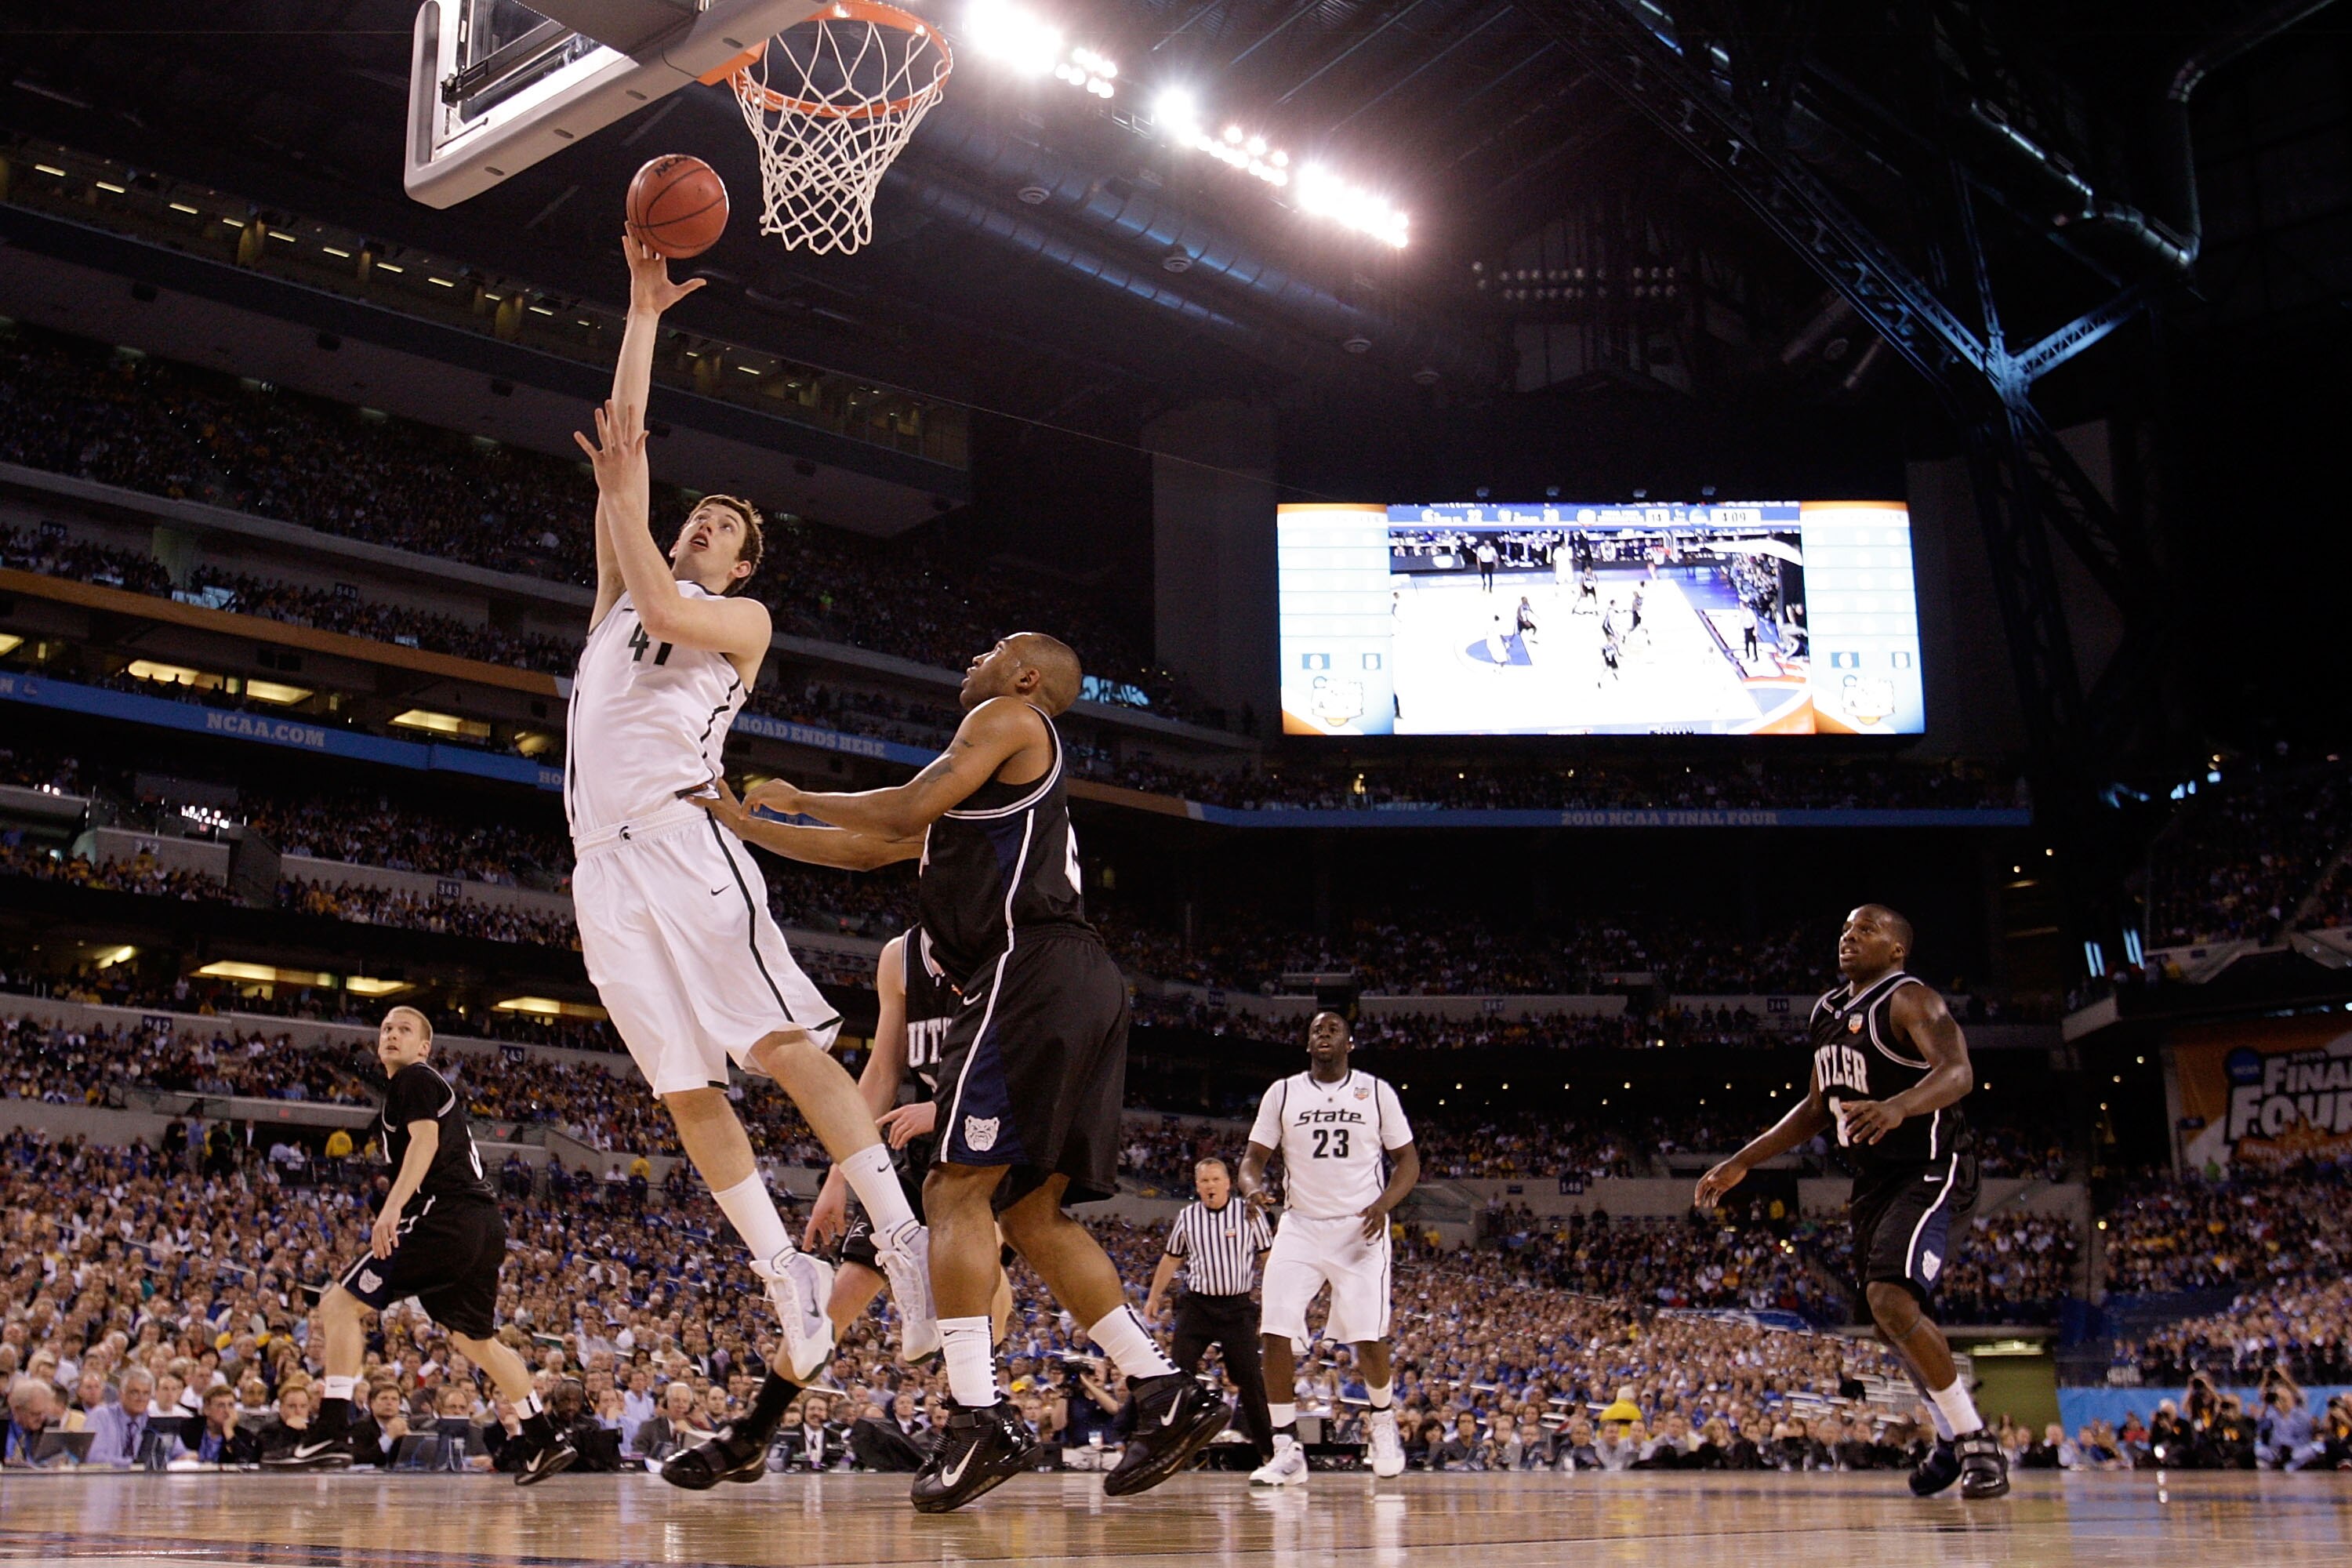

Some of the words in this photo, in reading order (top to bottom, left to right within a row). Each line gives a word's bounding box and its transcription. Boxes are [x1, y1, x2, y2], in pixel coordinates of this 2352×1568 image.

[207, 713, 325, 748] NCAA.COM
[739, 716, 788, 738] ROAD
[790, 726, 836, 749] ENDS
[838, 736, 885, 759] HERE
[1561, 811, 1606, 826] 2010
[1608, 812, 1661, 826] NCAA
[1667, 812, 1723, 826] FINAL
[1726, 812, 1777, 826] FOUR
[438, 884, 459, 898] 343
[1293, 1109, 1367, 1127] State
[1312, 1129, 1349, 1159] 23
[1561, 1181, 1581, 1193] 148
